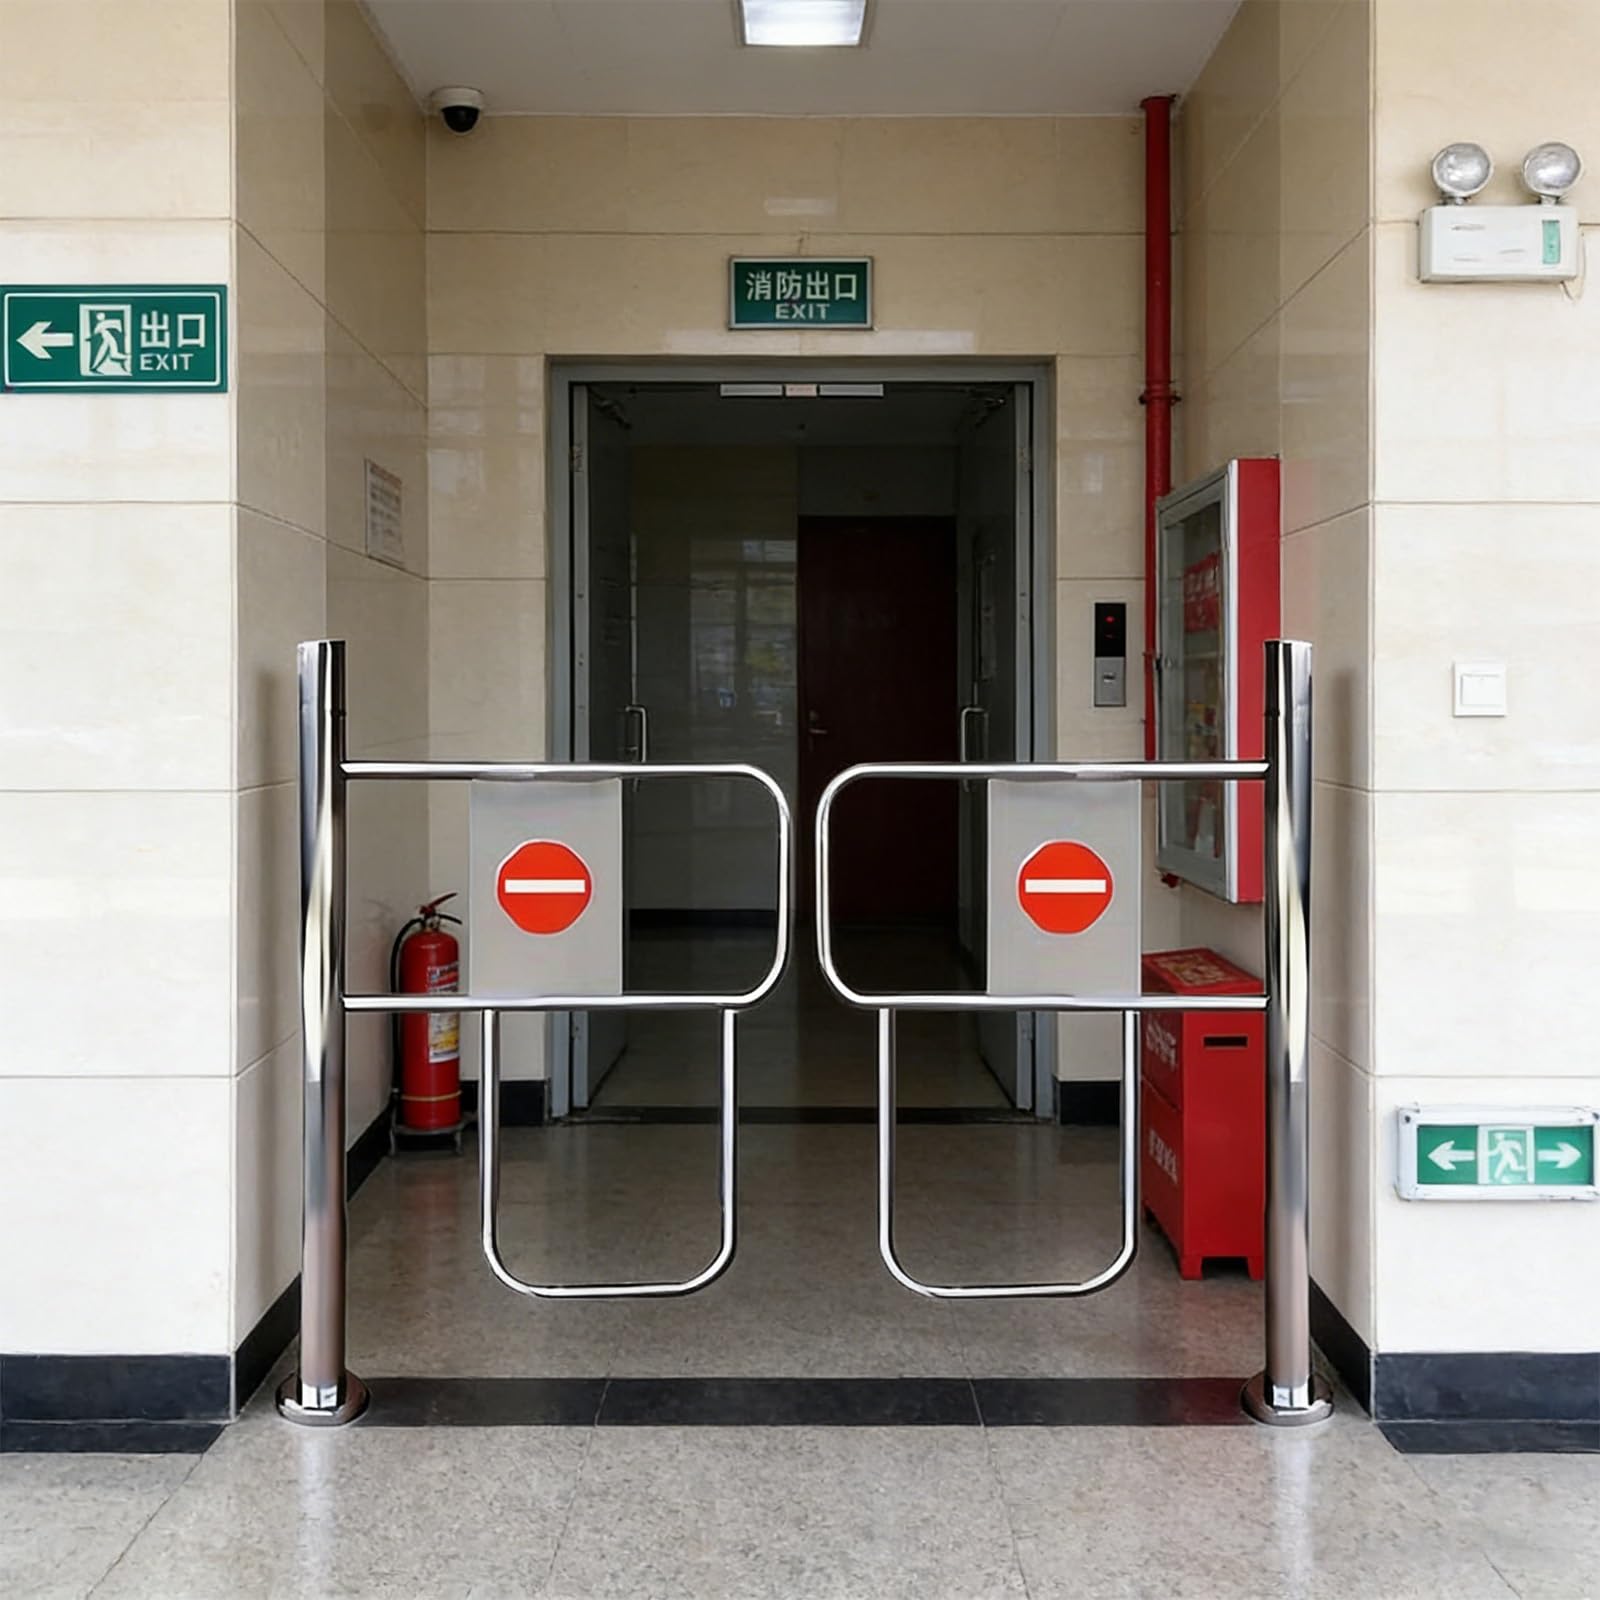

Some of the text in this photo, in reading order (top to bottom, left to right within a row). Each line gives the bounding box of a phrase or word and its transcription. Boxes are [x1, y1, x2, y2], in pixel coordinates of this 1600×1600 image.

[746, 269, 857, 300] 消防出口
[775, 303, 830, 319] EXIT
[140, 310, 205, 348] 出口
[140, 353, 194, 371] EXIT
